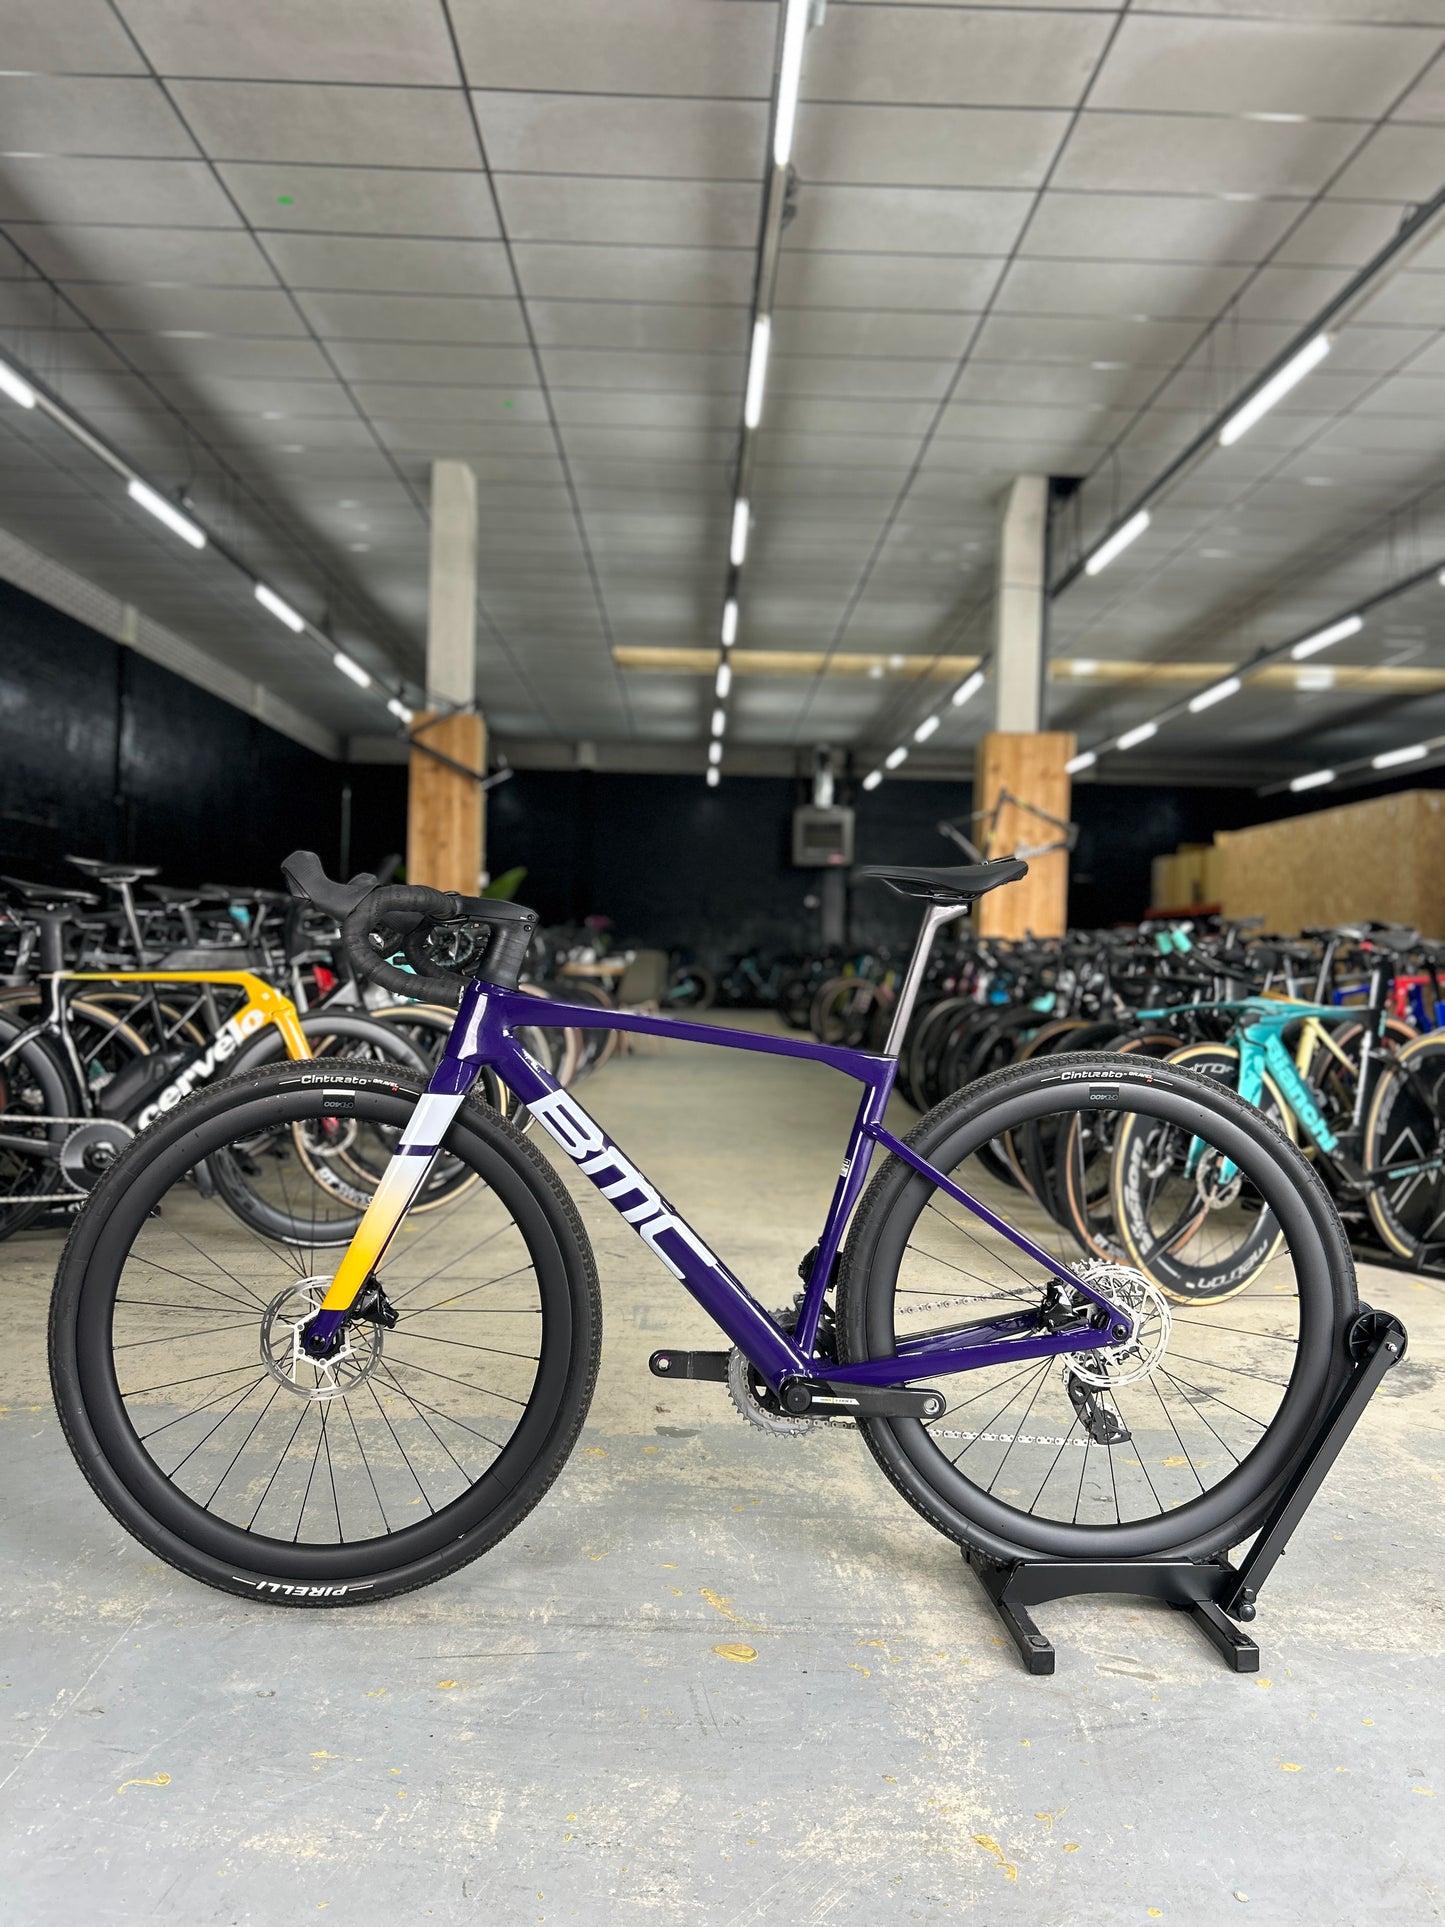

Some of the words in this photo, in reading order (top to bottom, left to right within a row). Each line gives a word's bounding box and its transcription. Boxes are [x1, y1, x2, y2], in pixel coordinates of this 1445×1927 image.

[301, 1074, 367, 1085] Cinturato
[373, 1078, 399, 1088] GRAVEL
[1061, 1070, 1123, 1081] Cinturato
[1264, 1033, 1340, 1153] Bianchi
[526, 1088, 718, 1280] BMC
[255, 1580, 349, 1597] PIRELLI
